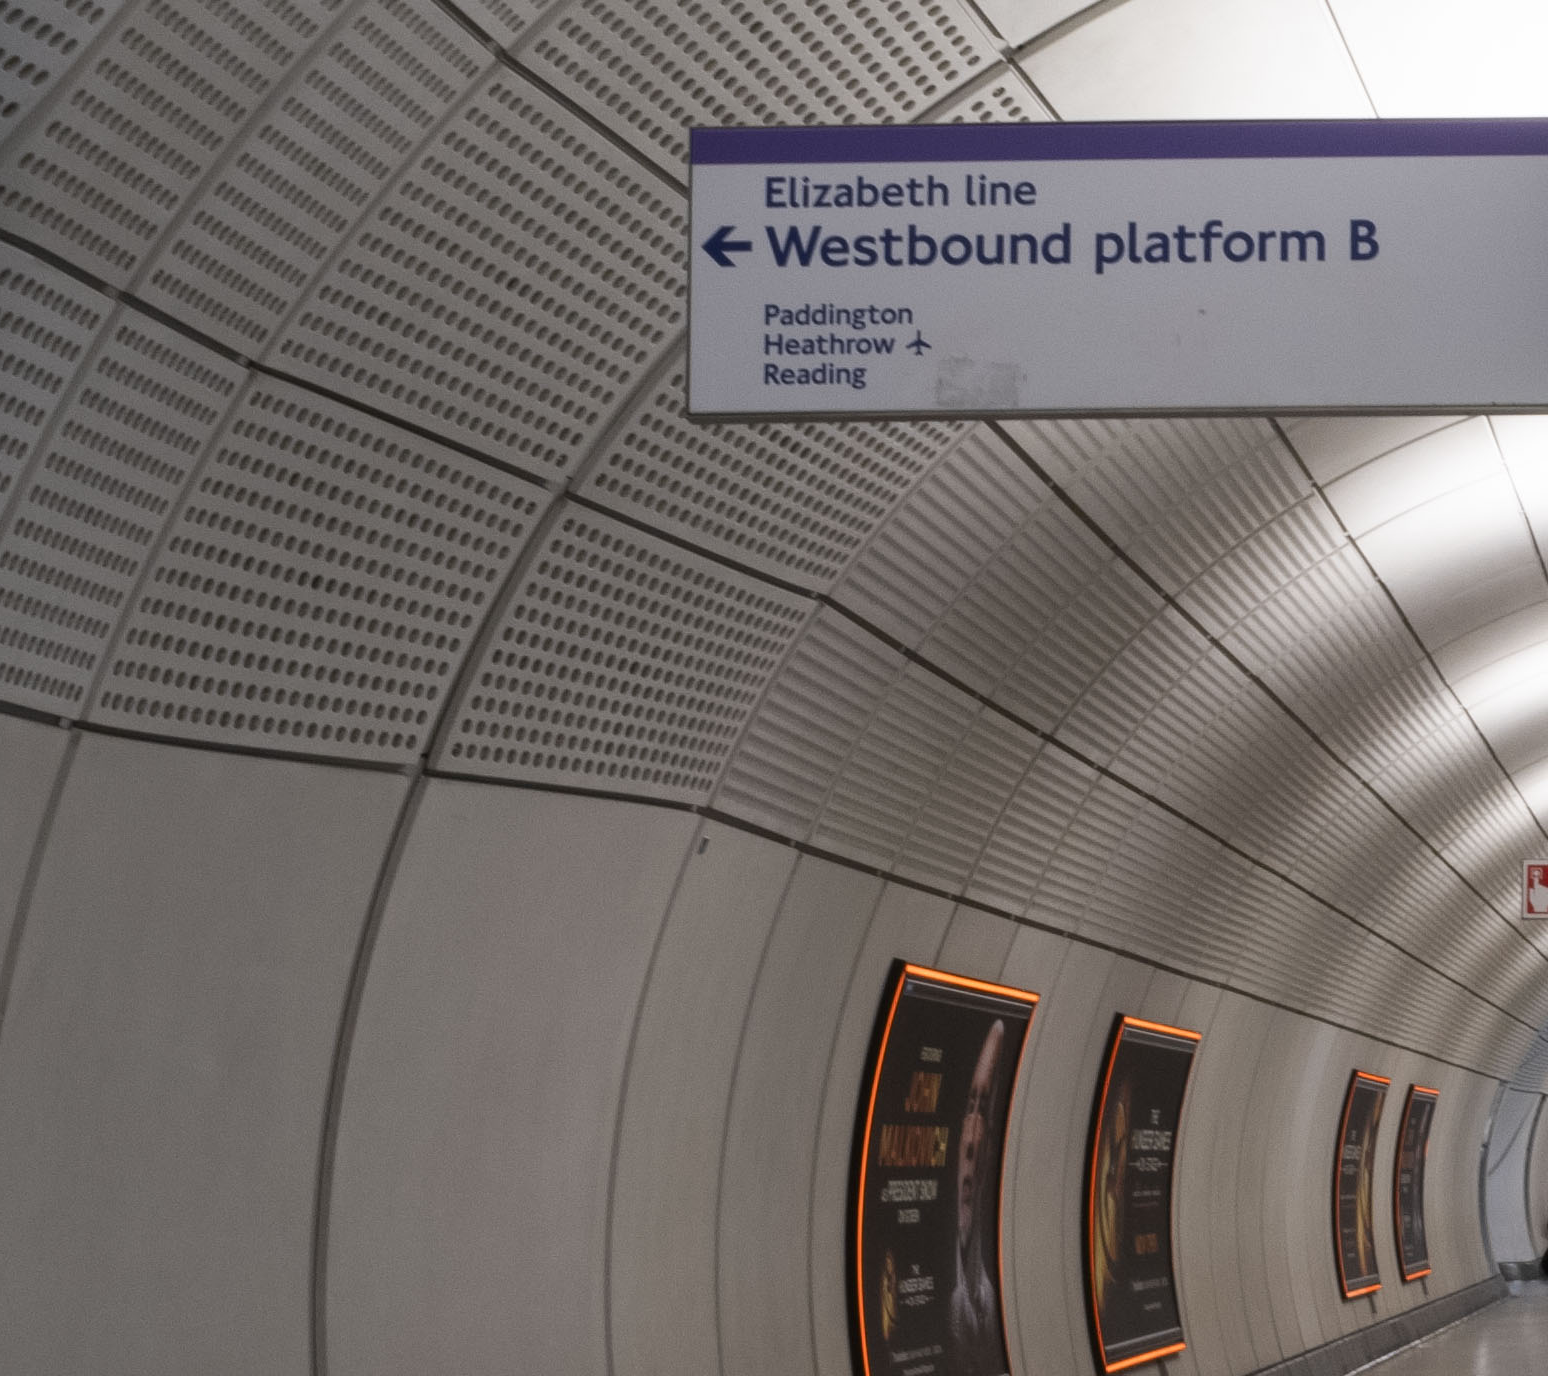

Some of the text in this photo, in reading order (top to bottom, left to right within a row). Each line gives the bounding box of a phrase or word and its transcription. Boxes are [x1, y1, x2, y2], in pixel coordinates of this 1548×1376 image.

[765, 174, 1037, 208] Elizabeth line
[764, 219, 1380, 274] Westbound platform B
[764, 303, 913, 330] Paddington
[764, 332, 896, 356] Heathrow
[763, 362, 867, 389] Reading
